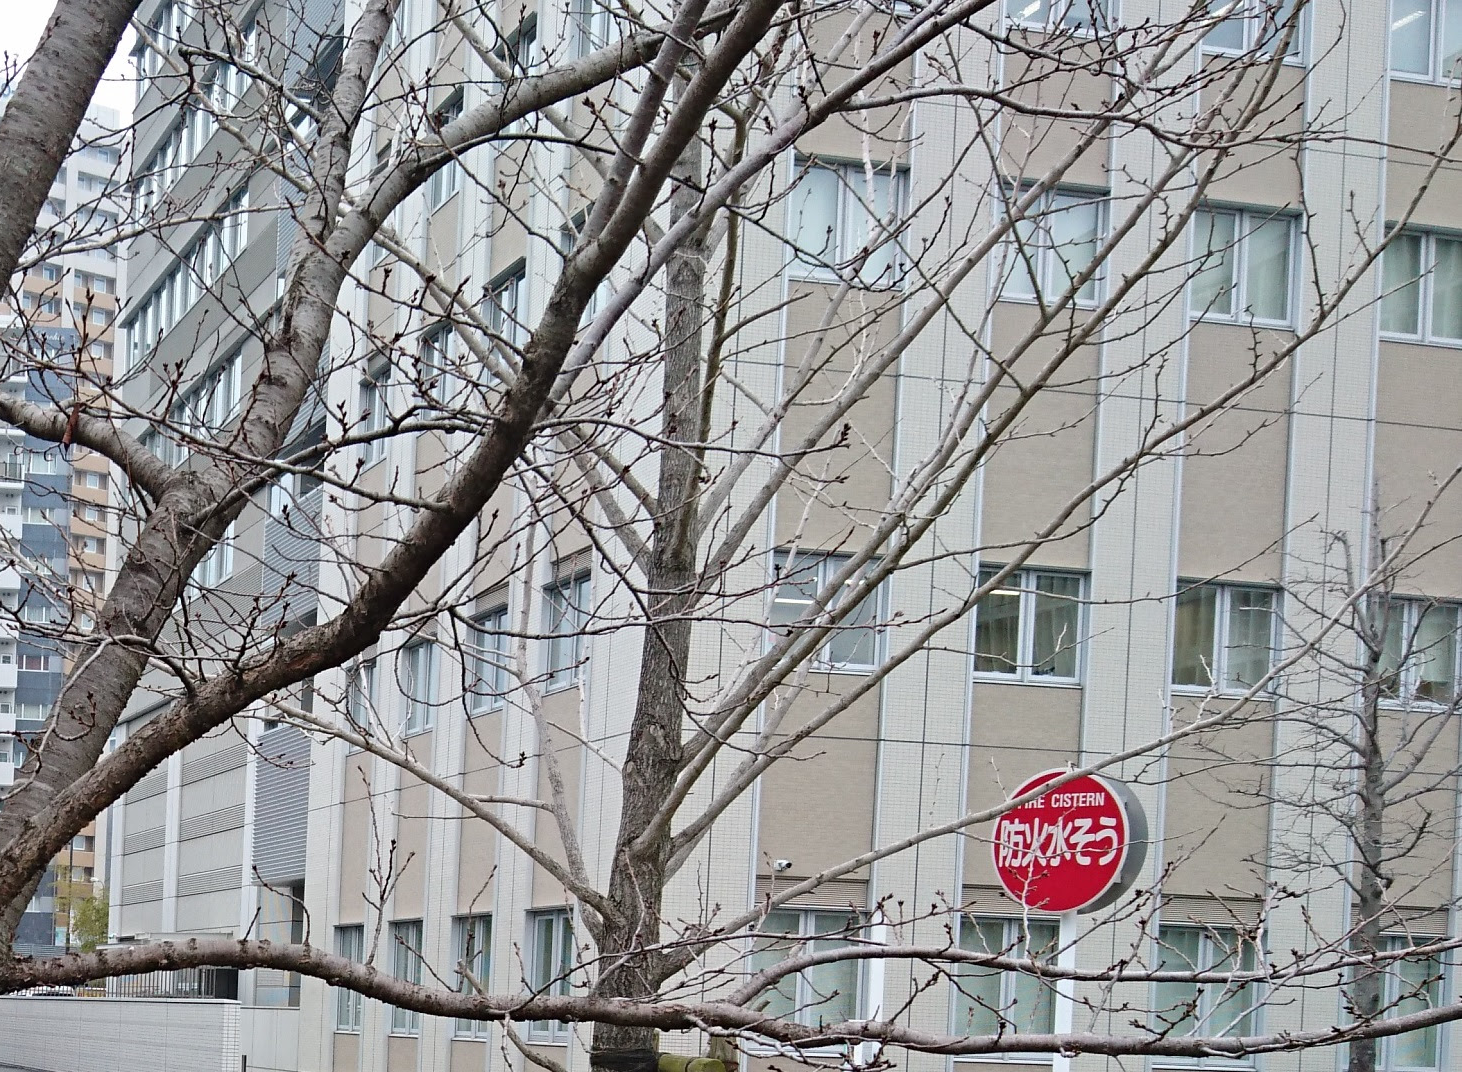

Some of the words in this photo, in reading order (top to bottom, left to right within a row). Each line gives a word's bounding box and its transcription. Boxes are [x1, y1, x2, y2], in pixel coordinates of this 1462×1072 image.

[1051, 792, 1105, 808] CISTERN
[999, 816, 1118, 867] 防火水そう
